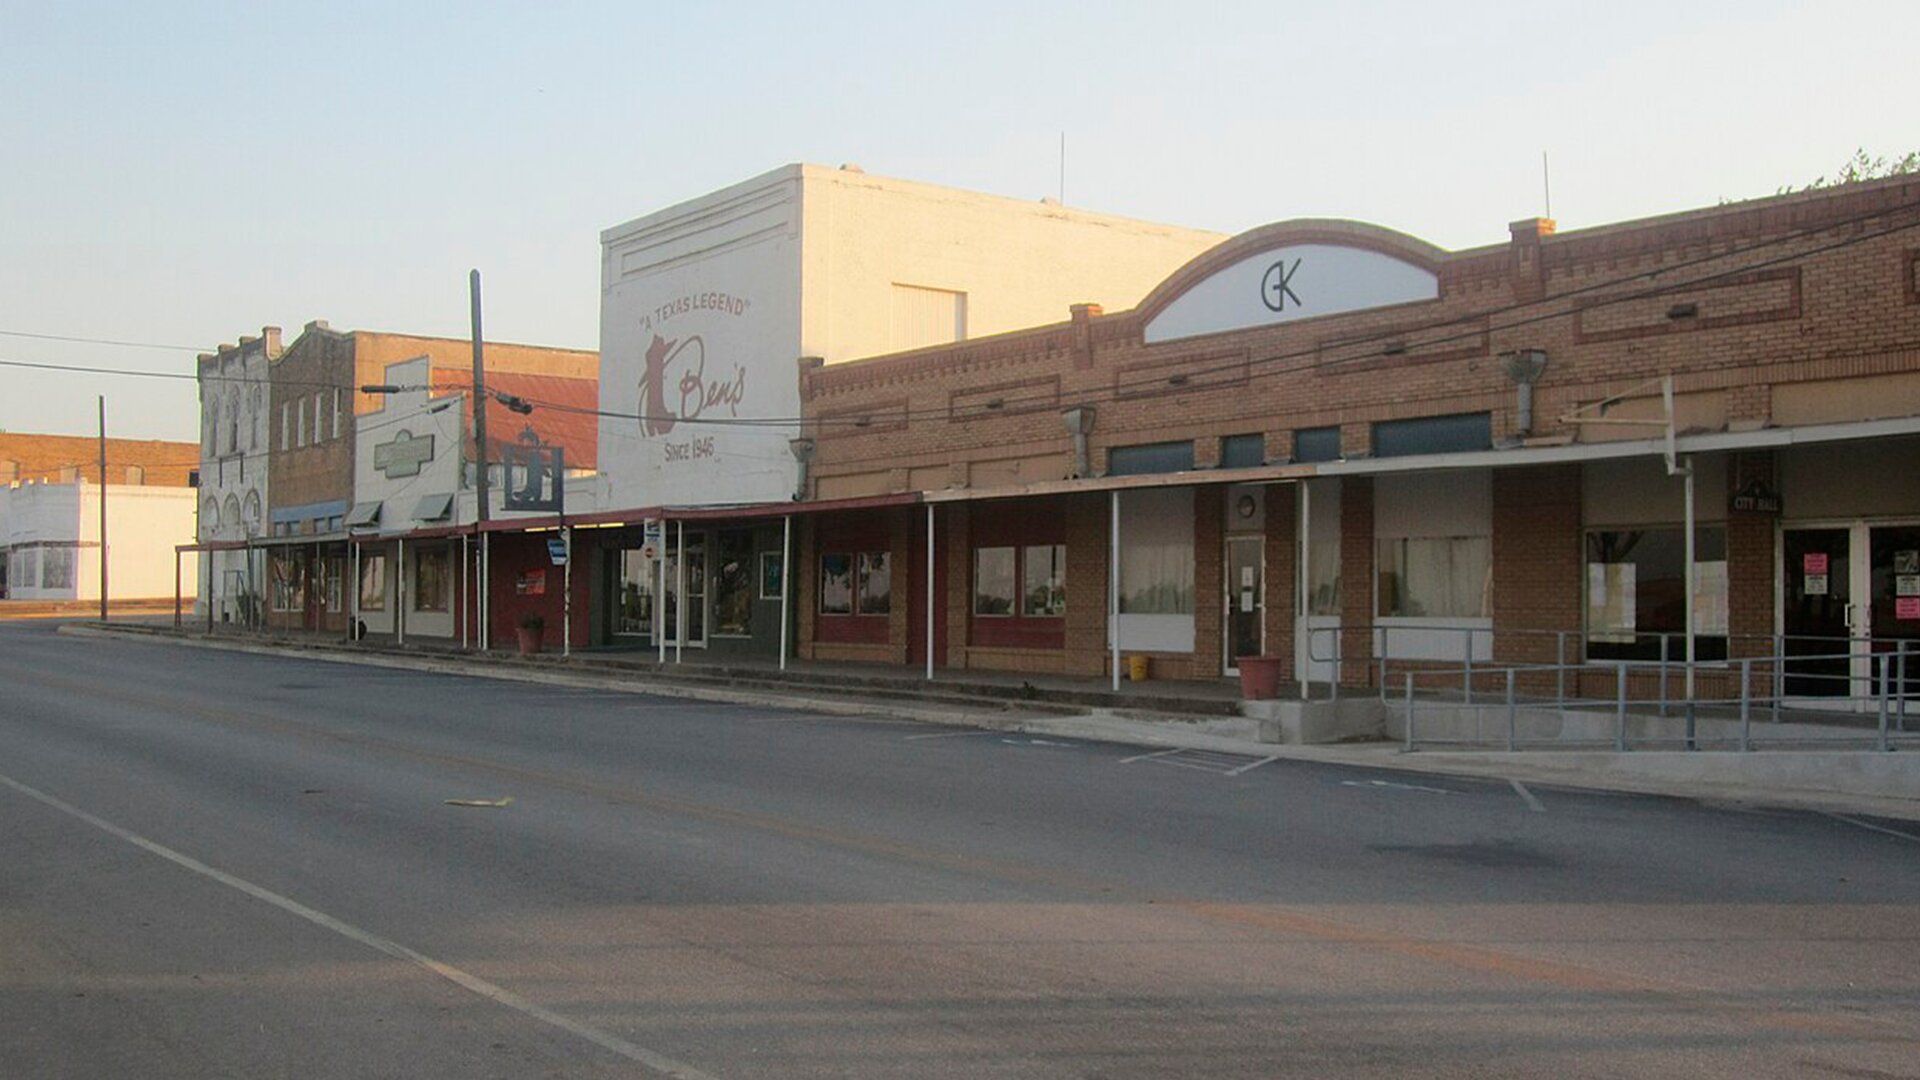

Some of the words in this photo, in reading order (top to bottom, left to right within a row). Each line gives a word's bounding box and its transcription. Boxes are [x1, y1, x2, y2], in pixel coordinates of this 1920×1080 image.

[655, 296, 690, 323] TEXAS
[664, 442, 689, 462] SINCE
[1734, 496, 1755, 510] CITY
[1757, 498, 1779, 512] HALL
